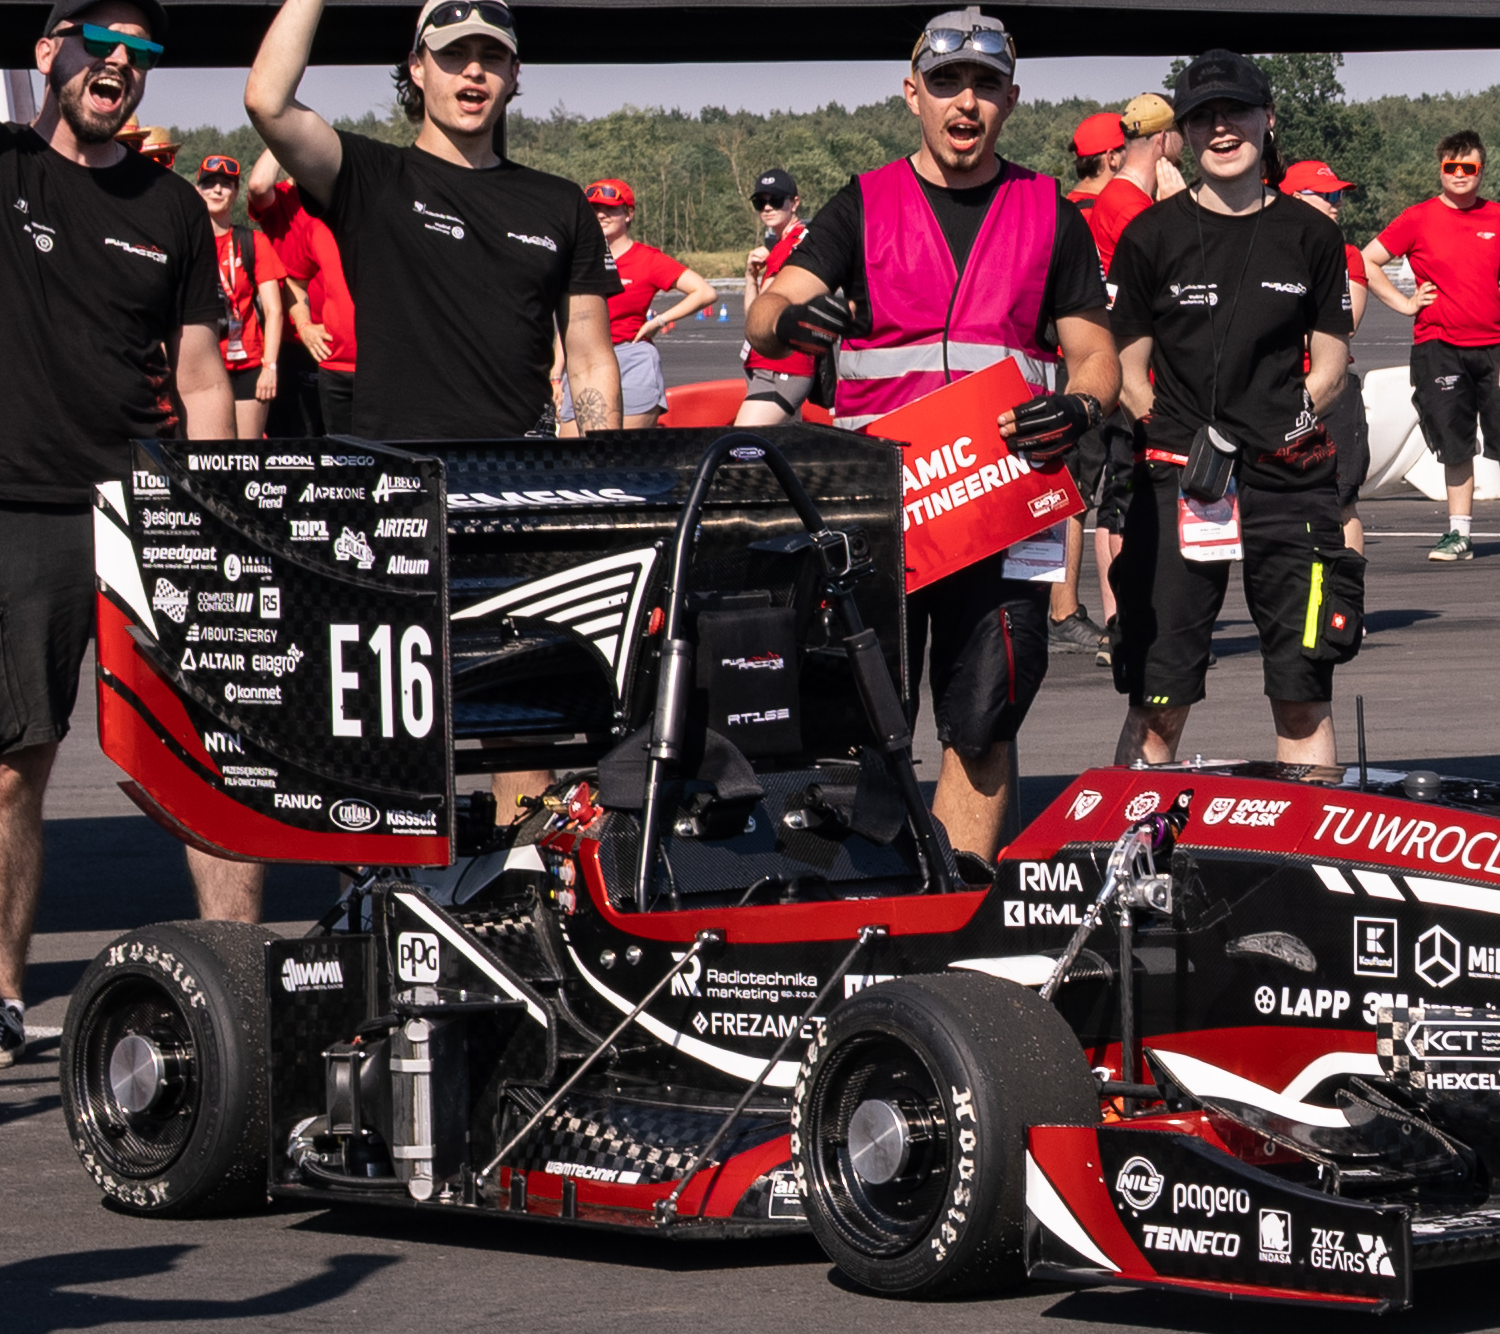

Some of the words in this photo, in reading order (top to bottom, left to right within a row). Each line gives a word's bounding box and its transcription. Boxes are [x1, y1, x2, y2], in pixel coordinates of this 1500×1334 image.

[199, 454, 259, 471] WOLFTEN
[265, 455, 315, 466] ANODAL
[903, 436, 977, 497] AMIC
[261, 482, 287, 495] Chem
[314, 487, 366, 500] APEXONE
[258, 496, 283, 509] Trend
[447, 488, 646, 509] EMENS
[290, 520, 329, 536] TOP1
[374, 518, 429, 538] AIRTECH
[142, 544, 217, 564] speedgoat
[387, 555, 430, 575] Altium
[197, 592, 235, 602] COMPUTER
[262, 595, 278, 611] RS
[197, 602, 235, 612] CONTROLS
[199, 652, 245, 671] ALTAIR
[330, 623, 434, 739] E16
[237, 685, 282, 699] konmet
[274, 793, 322, 810] FANUC
[1234, 798, 1291, 815] DOLNY
[1019, 862, 1083, 893] RMA
[400, 937, 437, 978] PPG
[706, 969, 818, 987] Radiotechnika
[706, 987, 779, 1003] marketing
[1280, 986, 1351, 1019] LAPP
[1423, 1030, 1478, 1051] KCT
[1119, 1173, 1162, 1192] NILS
[1173, 1182, 1250, 1218] pagero
[1142, 1223, 1240, 1258] TENNECO
[1311, 1227, 1345, 1251] ZKZ
[1258, 1251, 1291, 1264] INDASA
[1311, 1250, 1365, 1273] GEARS
